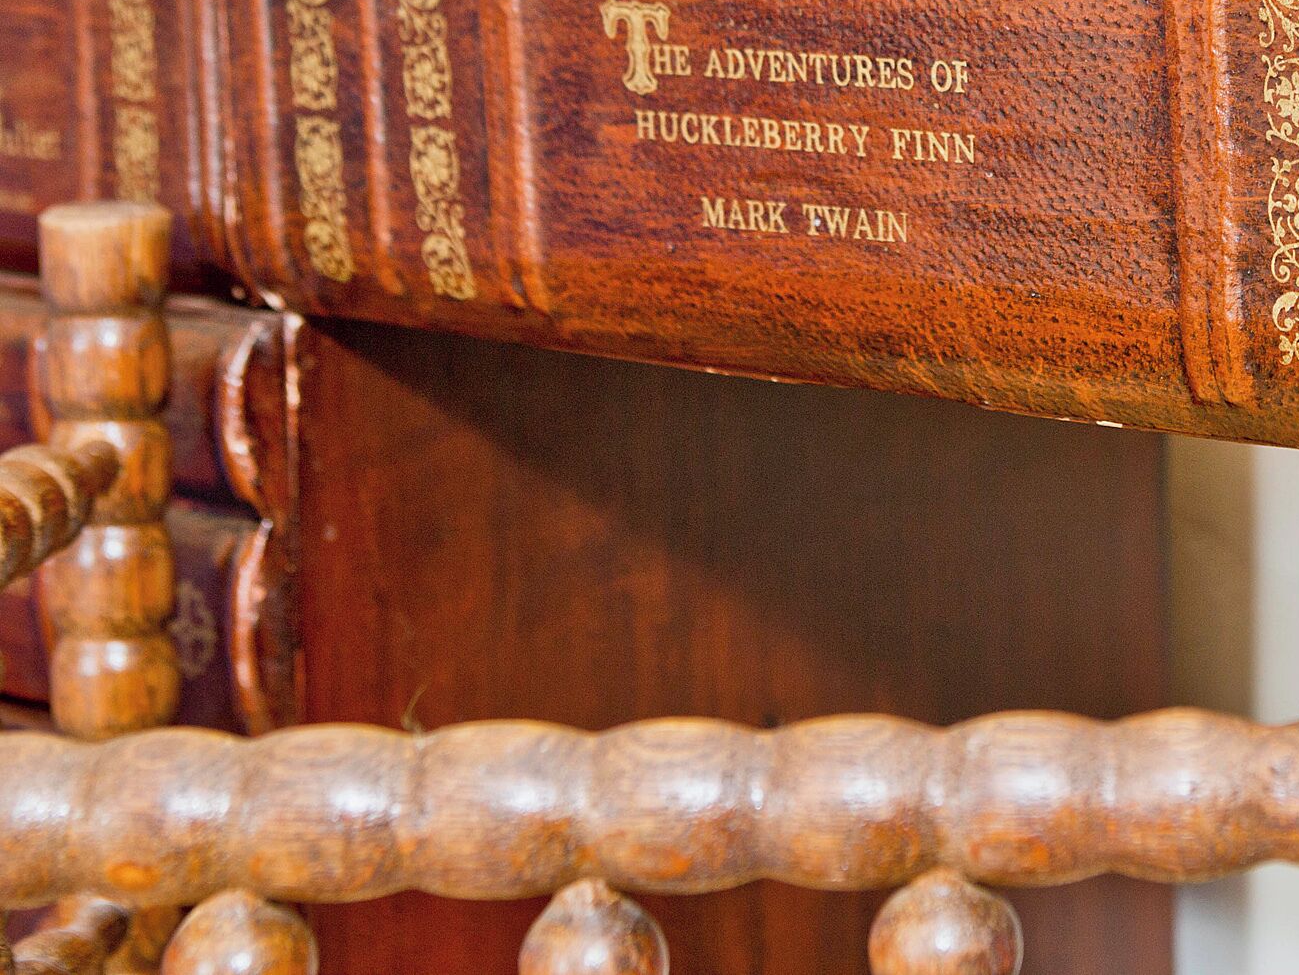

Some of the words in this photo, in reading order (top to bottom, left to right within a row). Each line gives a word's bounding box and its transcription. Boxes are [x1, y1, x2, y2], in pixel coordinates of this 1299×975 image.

[704, 47, 915, 92] ADVENTURES
[931, 60, 970, 94] OF
[635, 109, 870, 157] HUCKLEBERRY
[892, 127, 976, 165] FINN
[700, 195, 790, 235] MARK
[803, 203, 909, 243] TWAIN
